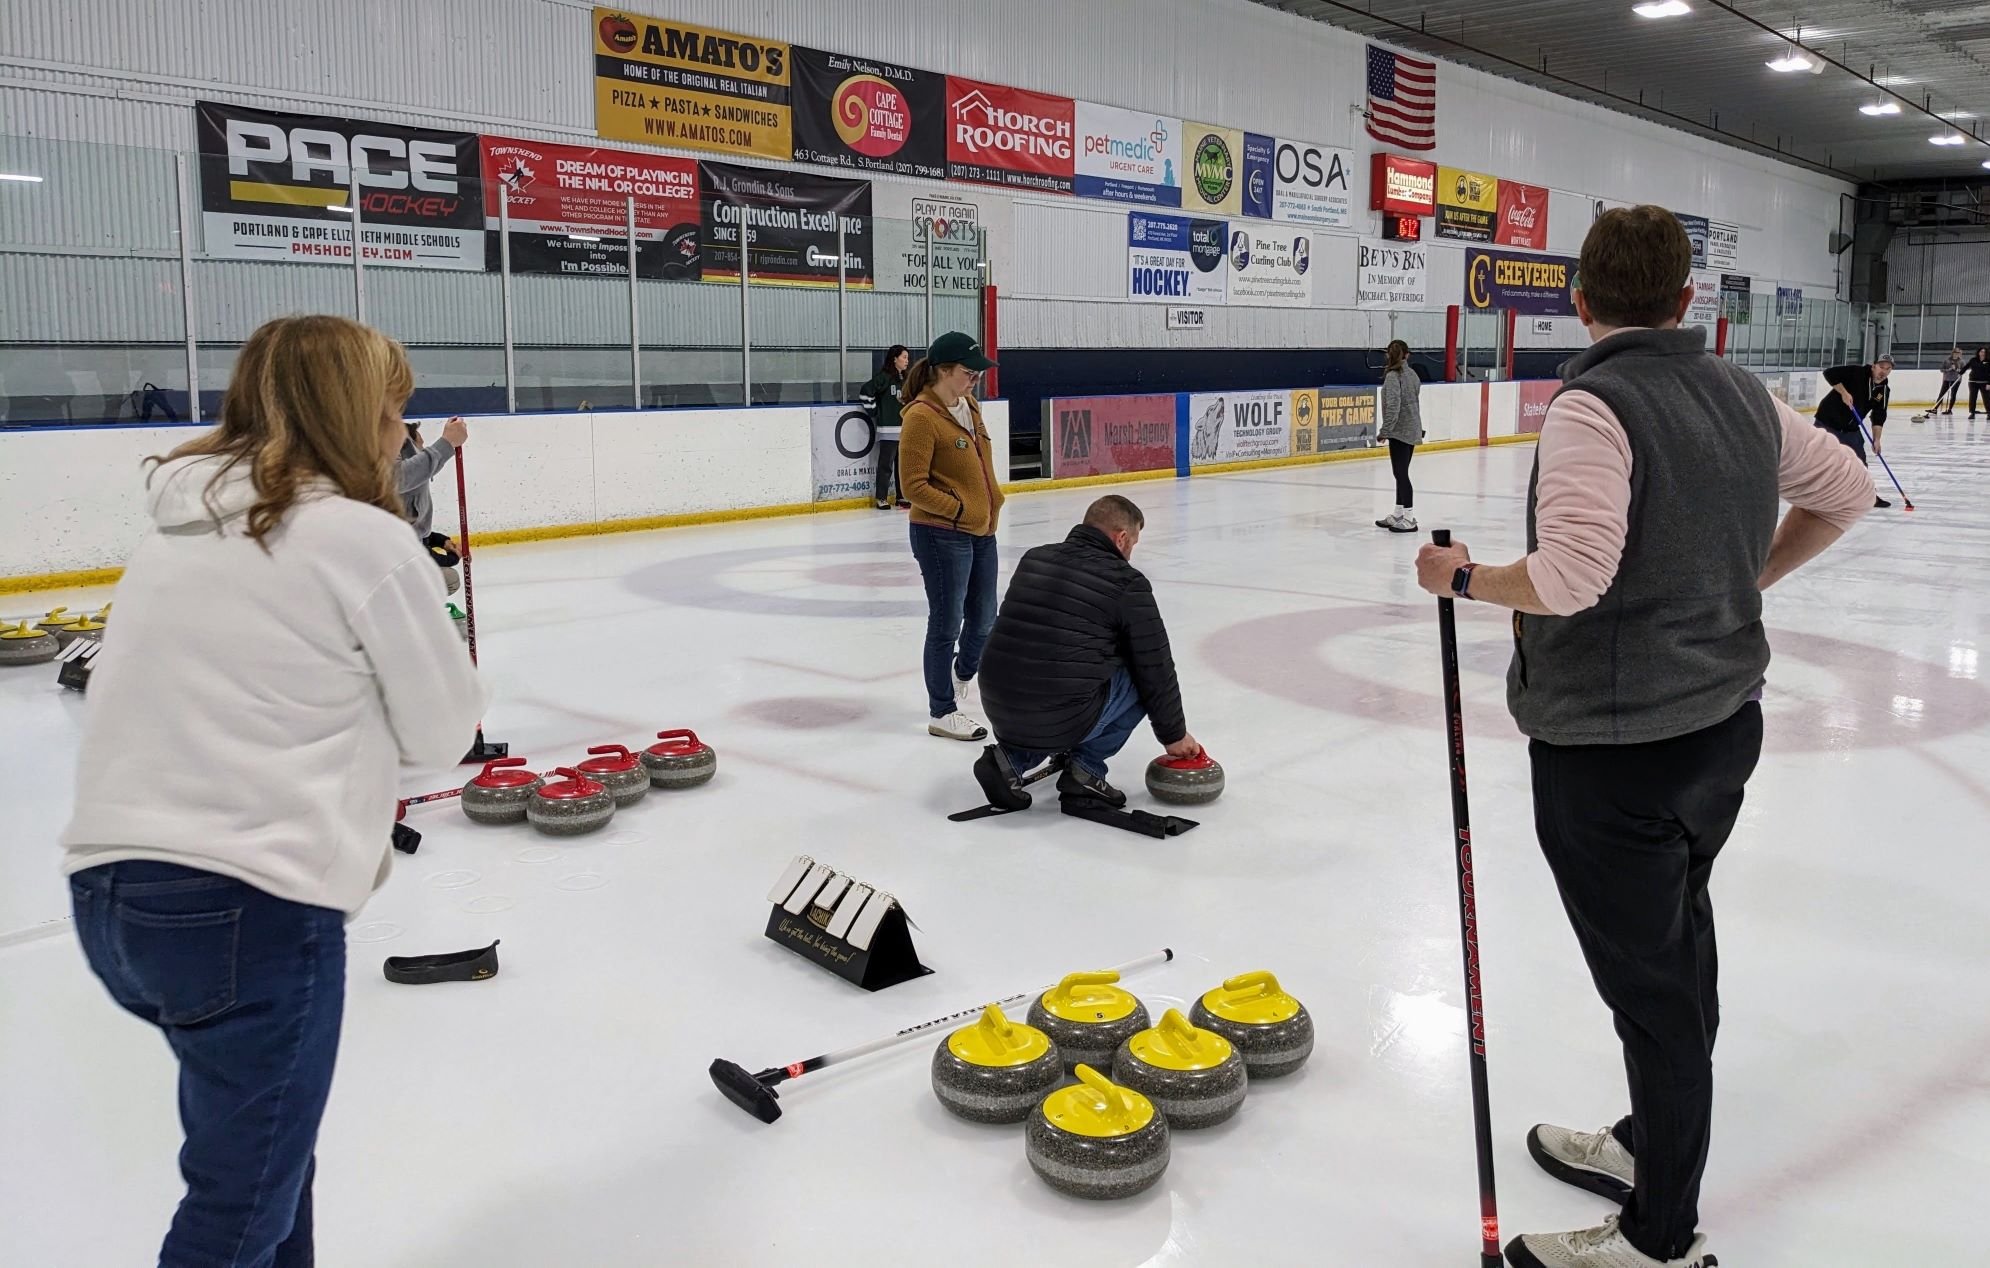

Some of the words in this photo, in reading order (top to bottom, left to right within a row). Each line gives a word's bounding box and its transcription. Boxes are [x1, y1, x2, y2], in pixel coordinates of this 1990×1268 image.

[641, 24, 783, 77] AMATO'S
[828, 56, 851, 72] Emily
[852, 60, 882, 77] Nelson,
[885, 66, 914, 82] D.M.D.
[623, 63, 648, 79] HOME
[651, 68, 661, 81] OF
[664, 69, 679, 83] THE
[682, 72, 718, 90] ORIGINAL
[720, 79, 738, 93] REAL
[740, 81, 767, 97] ITALIAN
[612, 90, 646, 109] PIZZA
[664, 97, 700, 117] PASTA
[714, 104, 778, 128] SANDWICHES
[876, 91, 897, 110] CAPE
[869, 108, 904, 129] COTTAGE
[986, 106, 1071, 138] HORCH
[644, 117, 752, 147] WWW.AMATOS.COM
[870, 126, 887, 140] Family
[887, 130, 903, 141] Dental
[956, 124, 1071, 159] ROOFING
[1085, 134, 1154, 162] petmedic
[226, 119, 458, 194] PACE
[490, 146, 543, 161] TOWNSHEND
[794, 148, 809, 160] 463
[811, 151, 838, 165] Cottage
[896, 162, 913, 174] (207)
[915, 165, 945, 177] 799-1681
[556, 159, 606, 177] DREAM
[607, 164, 625, 178] OF
[627, 167, 679, 184] PLAYING
[680, 173, 693, 186] IN
[1110, 161, 1136, 172] URGENT
[1137, 165, 1154, 175] CARE
[1194, 162, 1233, 181] MVMC
[1275, 143, 1348, 190] OSA
[951, 164, 967, 178] (207)
[969, 167, 980, 178] 273
[986, 170, 1001, 180] 1111
[1007, 174, 1071, 190] www.horchroofing.com
[1386, 167, 1434, 191] Hammond
[556, 174, 584, 189] THE
[586, 176, 613, 191] NHL
[614, 180, 633, 193] OR
[634, 182, 695, 199] COLLEGE?
[713, 176, 730, 191] R.J.
[731, 178, 765, 194] Grondin
[767, 181, 774, 195] &
[775, 183, 795, 197] Sons
[1103, 188, 1114, 196] after
[1115, 190, 1128, 199] hours
[1134, 192, 1157, 201] weekends
[572, 197, 589, 205] HAVE
[602, 199, 620, 207] MORE
[590, 206, 616, 214] COLLEGE
[915, 203, 937, 215] PLAY
[939, 206, 947, 217] IT
[949, 207, 975, 219] AGAIN
[561, 211, 582, 219] OTHER
[583, 213, 614, 221] PROGRAM
[713, 200, 798, 229] Contruction
[800, 209, 862, 235] Excellnce
[233, 222, 289, 238] PORTLAND
[292, 225, 300, 238] &
[302, 226, 329, 240] CAPE
[384, 232, 419, 246] MIDDLE
[421, 234, 460, 248] SCHOOLS
[713, 227, 737, 241] SINCE
[1192, 229, 1210, 243] total
[1708, 229, 1737, 244] PORTLAND
[292, 242, 413, 260] PMSHOCEY.COM
[547, 239, 562, 249] We
[564, 241, 583, 249] turn
[584, 241, 597, 250] the
[1192, 243, 1221, 256] mortgage
[1256, 239, 1270, 251] Pine
[1272, 241, 1287, 252] Tree
[590, 252, 607, 260] into
[933, 256, 952, 269] ALL
[1150, 255, 1165, 267] GREAT
[1250, 254, 1275, 268] Curling
[1276, 256, 1292, 267] Club
[1359, 245, 1399, 268] BEV'S
[1402, 250, 1426, 271] BIN
[561, 260, 578, 271] I'm
[581, 262, 630, 273] Possible.
[1495, 259, 1566, 288] CHEVERUS
[903, 273, 948, 289] HOCEY
[1367, 273, 1377, 284] IN
[1377, 274, 1405, 286] MEMORY
[1407, 276, 1416, 286] OF
[1358, 289, 1388, 301] MICHAEL
[1389, 291, 1424, 303] BEVERIDGE
[1177, 310, 1203, 325] VISITOR
[1537, 320, 1552, 331] HOME
[1321, 397, 1337, 408] YOUR
[1339, 396, 1354, 407] GOAL
[1355, 395, 1375, 406] AFTER
[1233, 401, 1283, 428] WOLF
[1321, 408, 1344, 427] THE
[1345, 406, 1375, 426] GAME
[1104, 421, 1134, 446] Marsh
[1138, 421, 1170, 446] Agency
[1233, 428, 1264, 438] TECHNOLOGY
[1265, 427, 1282, 436] GROUP
[837, 468, 852, 478] ORAL
[1459, 825, 1486, 1063] TOURNAMENT
